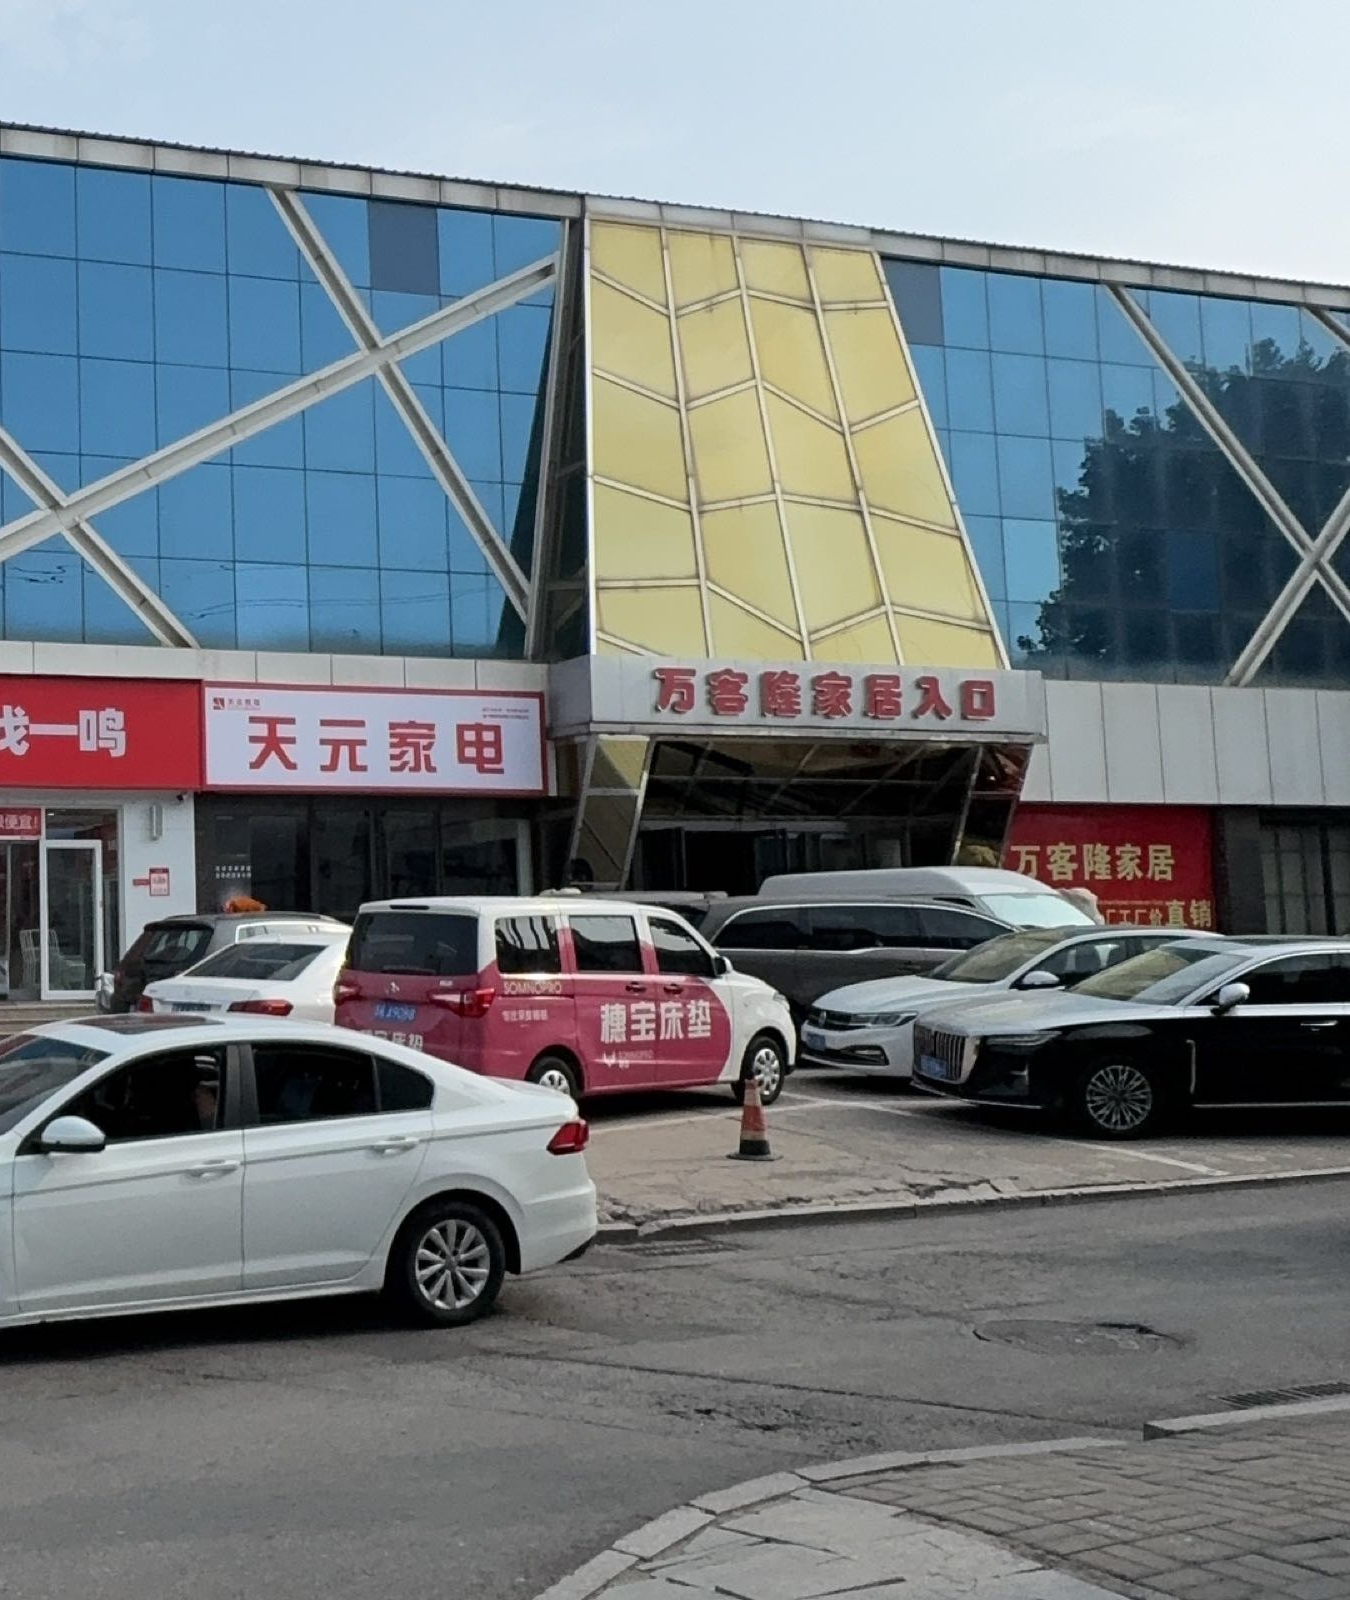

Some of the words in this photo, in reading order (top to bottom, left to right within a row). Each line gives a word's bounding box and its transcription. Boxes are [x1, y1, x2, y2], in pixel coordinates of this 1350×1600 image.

[653, 668, 996, 721] 万客隆家居入口
[248, 715, 505, 775] 天元家电
[1011, 842, 1176, 881] 万客隆家居
[503, 980, 562, 995] SOMNOPRO
[600, 999, 711, 1044] 穗宝床垫
